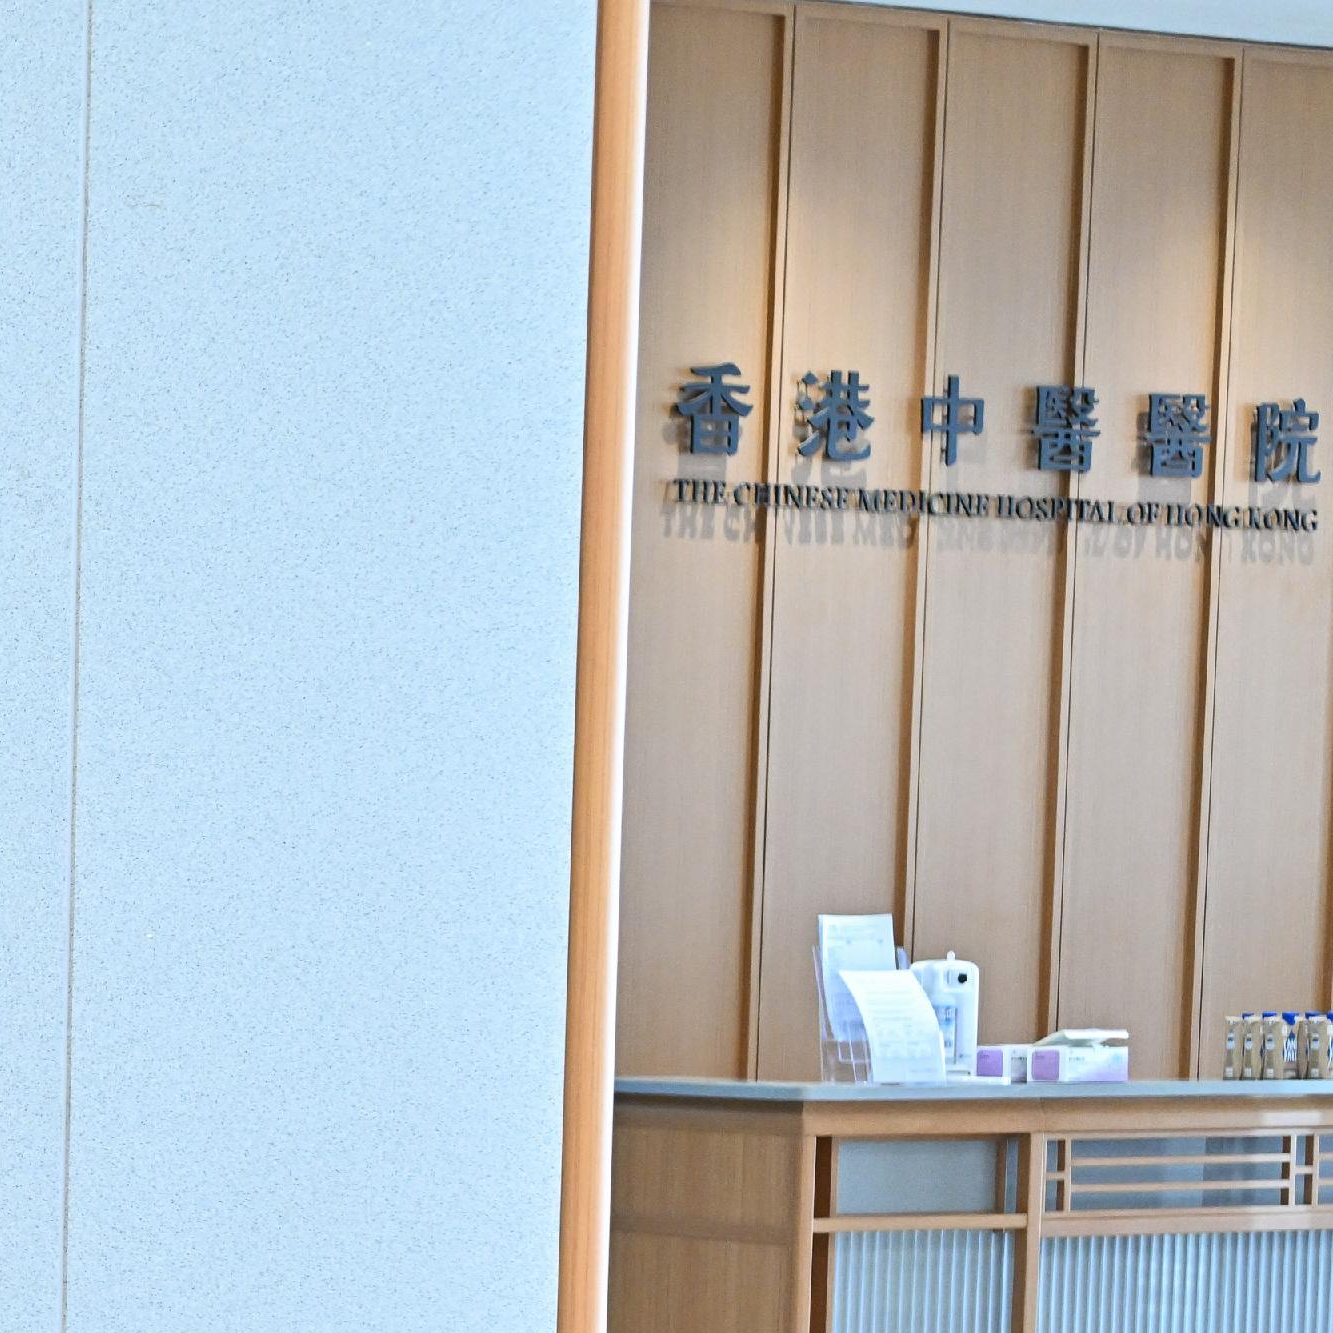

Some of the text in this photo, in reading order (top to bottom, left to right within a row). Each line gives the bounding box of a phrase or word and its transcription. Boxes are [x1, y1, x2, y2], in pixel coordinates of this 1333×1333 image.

[677, 362, 1321, 484] 香港中醫醫院
[675, 478, 1318, 531] THE CHINESE MEDICINE HOSPITAL OF HONG KONG
